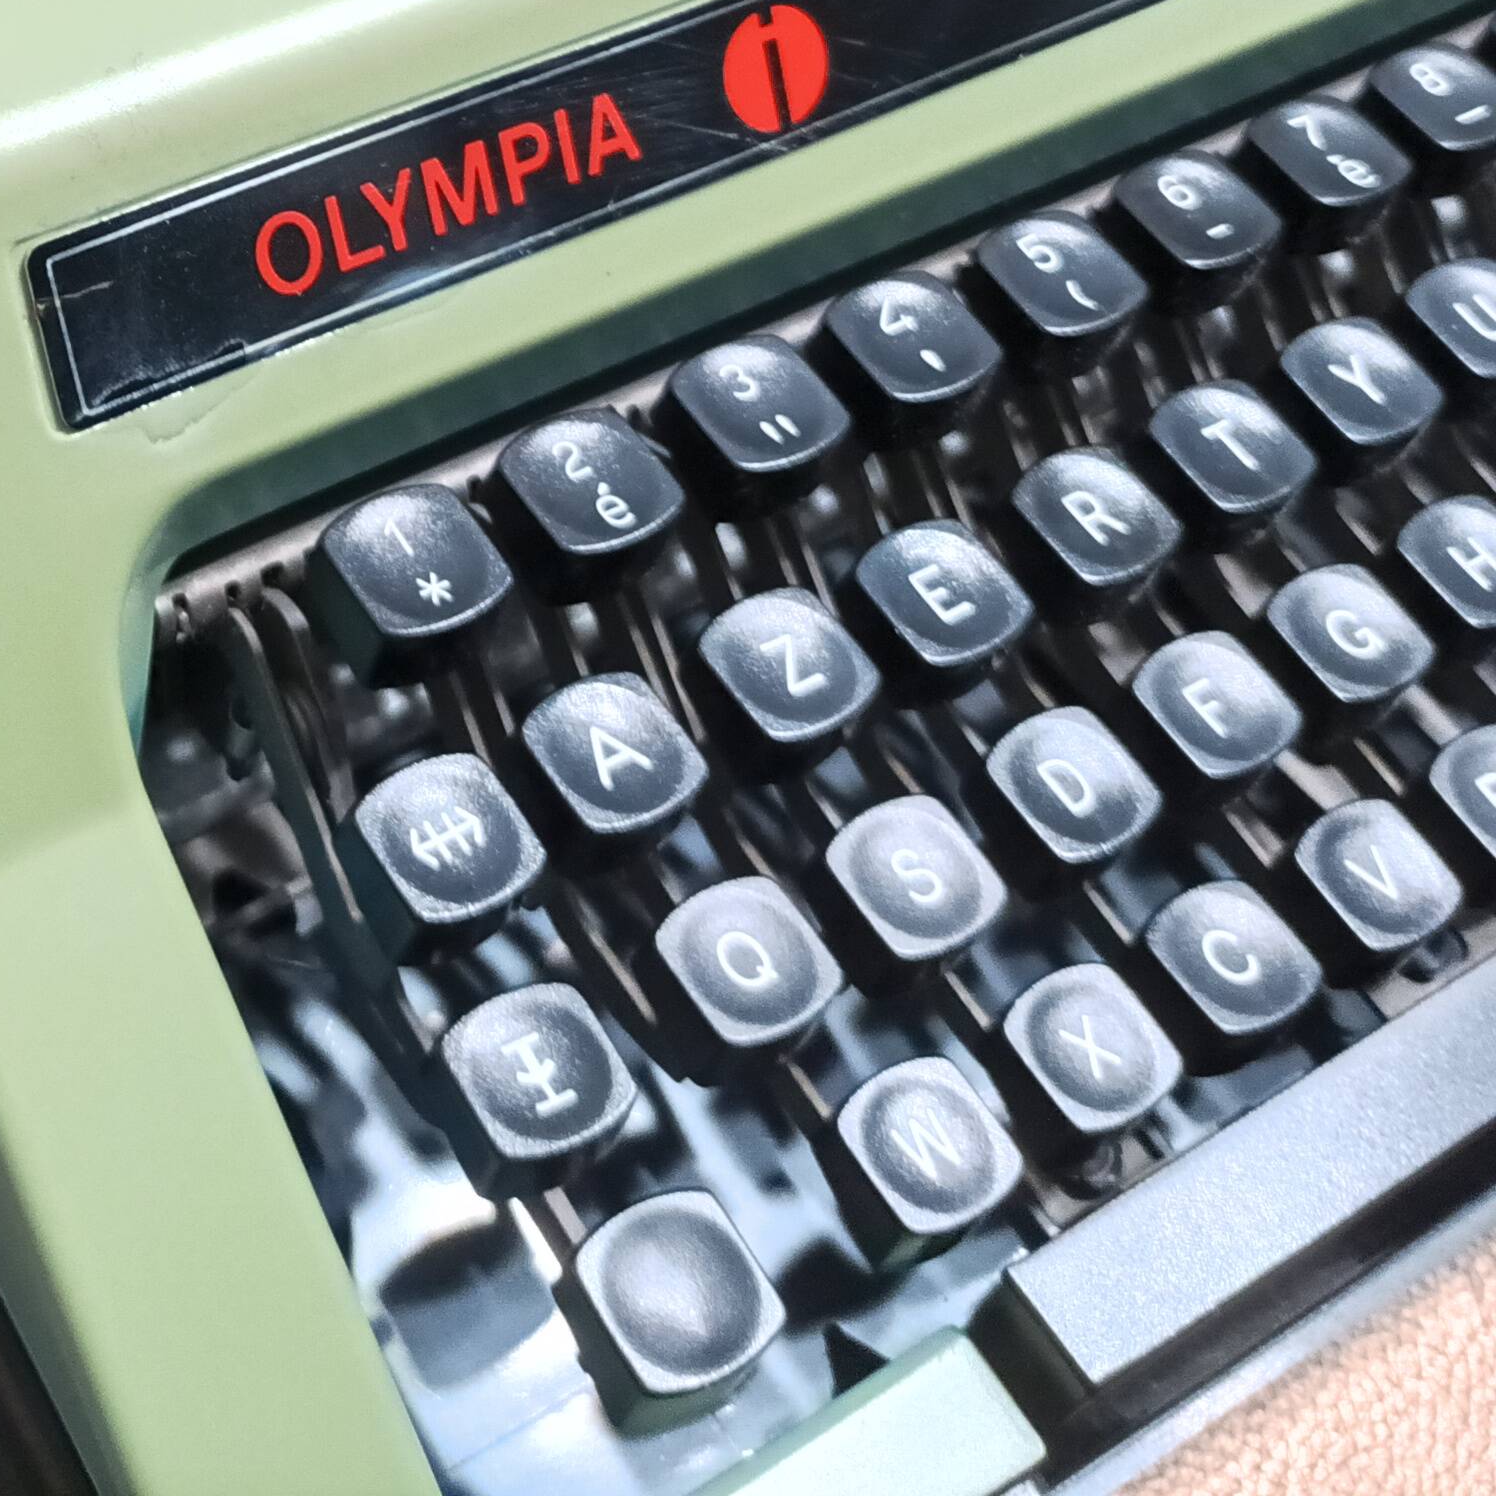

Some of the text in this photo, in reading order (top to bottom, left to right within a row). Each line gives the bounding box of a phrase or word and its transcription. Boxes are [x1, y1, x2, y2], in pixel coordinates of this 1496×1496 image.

[1409, 62, 1452, 96] 8
[1287, 114, 1327, 150] 7
[255, 92, 642, 296] OLYMPIA
[1156, 174, 1201, 210] 6
[1016, 234, 1064, 273] 5
[879, 292, 919, 336] 4
[718, 363, 761, 401] 3
[1328, 355, 1387, 404] Y
[551, 440, 593, 482] 2
[1200, 419, 1260, 473] T
[383, 519, 415, 557] 1
[1061, 490, 1132, 545] R
[908, 564, 976, 625] E
[1325, 609, 1387, 659] G
[759, 634, 827, 697] Z
[1181, 678, 1230, 739] F
[589, 725, 652, 791] A
[1036, 758, 1094, 818] D
[890, 848, 944, 905] S
[1343, 845, 1400, 901] V
[716, 931, 780, 990] Q
[1201, 929, 1261, 986] C
[1058, 1014, 1122, 1079] X
[888, 1107, 963, 1179] W
